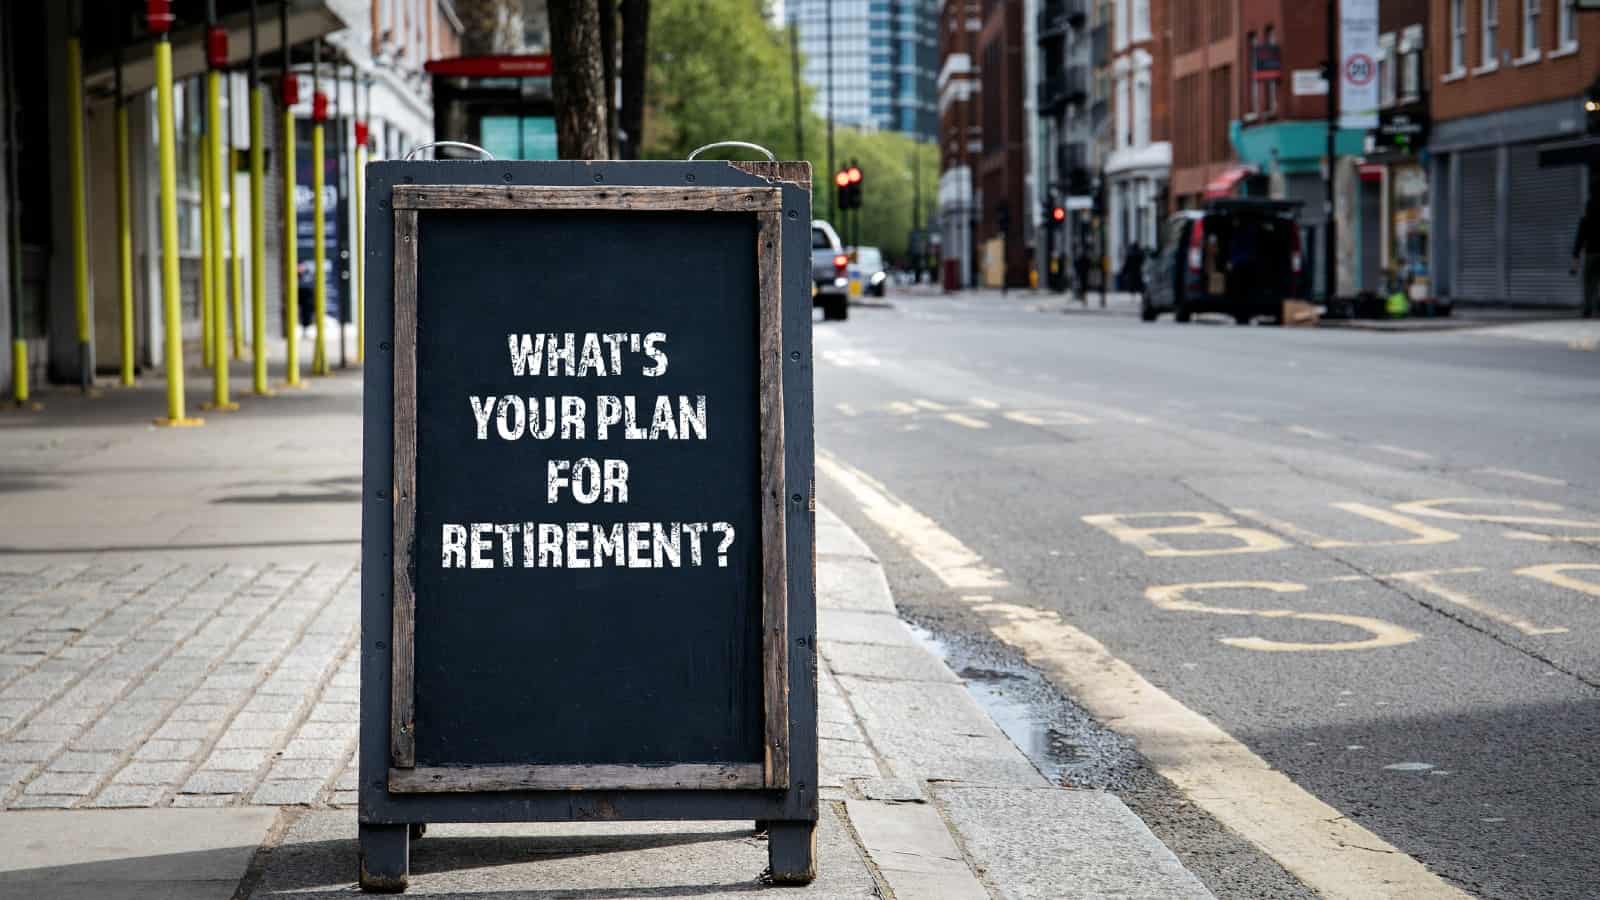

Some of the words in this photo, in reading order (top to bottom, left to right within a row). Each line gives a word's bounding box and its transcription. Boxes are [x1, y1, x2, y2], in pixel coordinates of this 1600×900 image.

[508, 332, 669, 377] WHAT'S
[469, 395, 587, 440] YOUR
[596, 395, 708, 440] PLAN
[547, 457, 629, 504] FOR
[441, 522, 736, 569] RETIREMENT?
[1081, 498, 1600, 556] BUS
